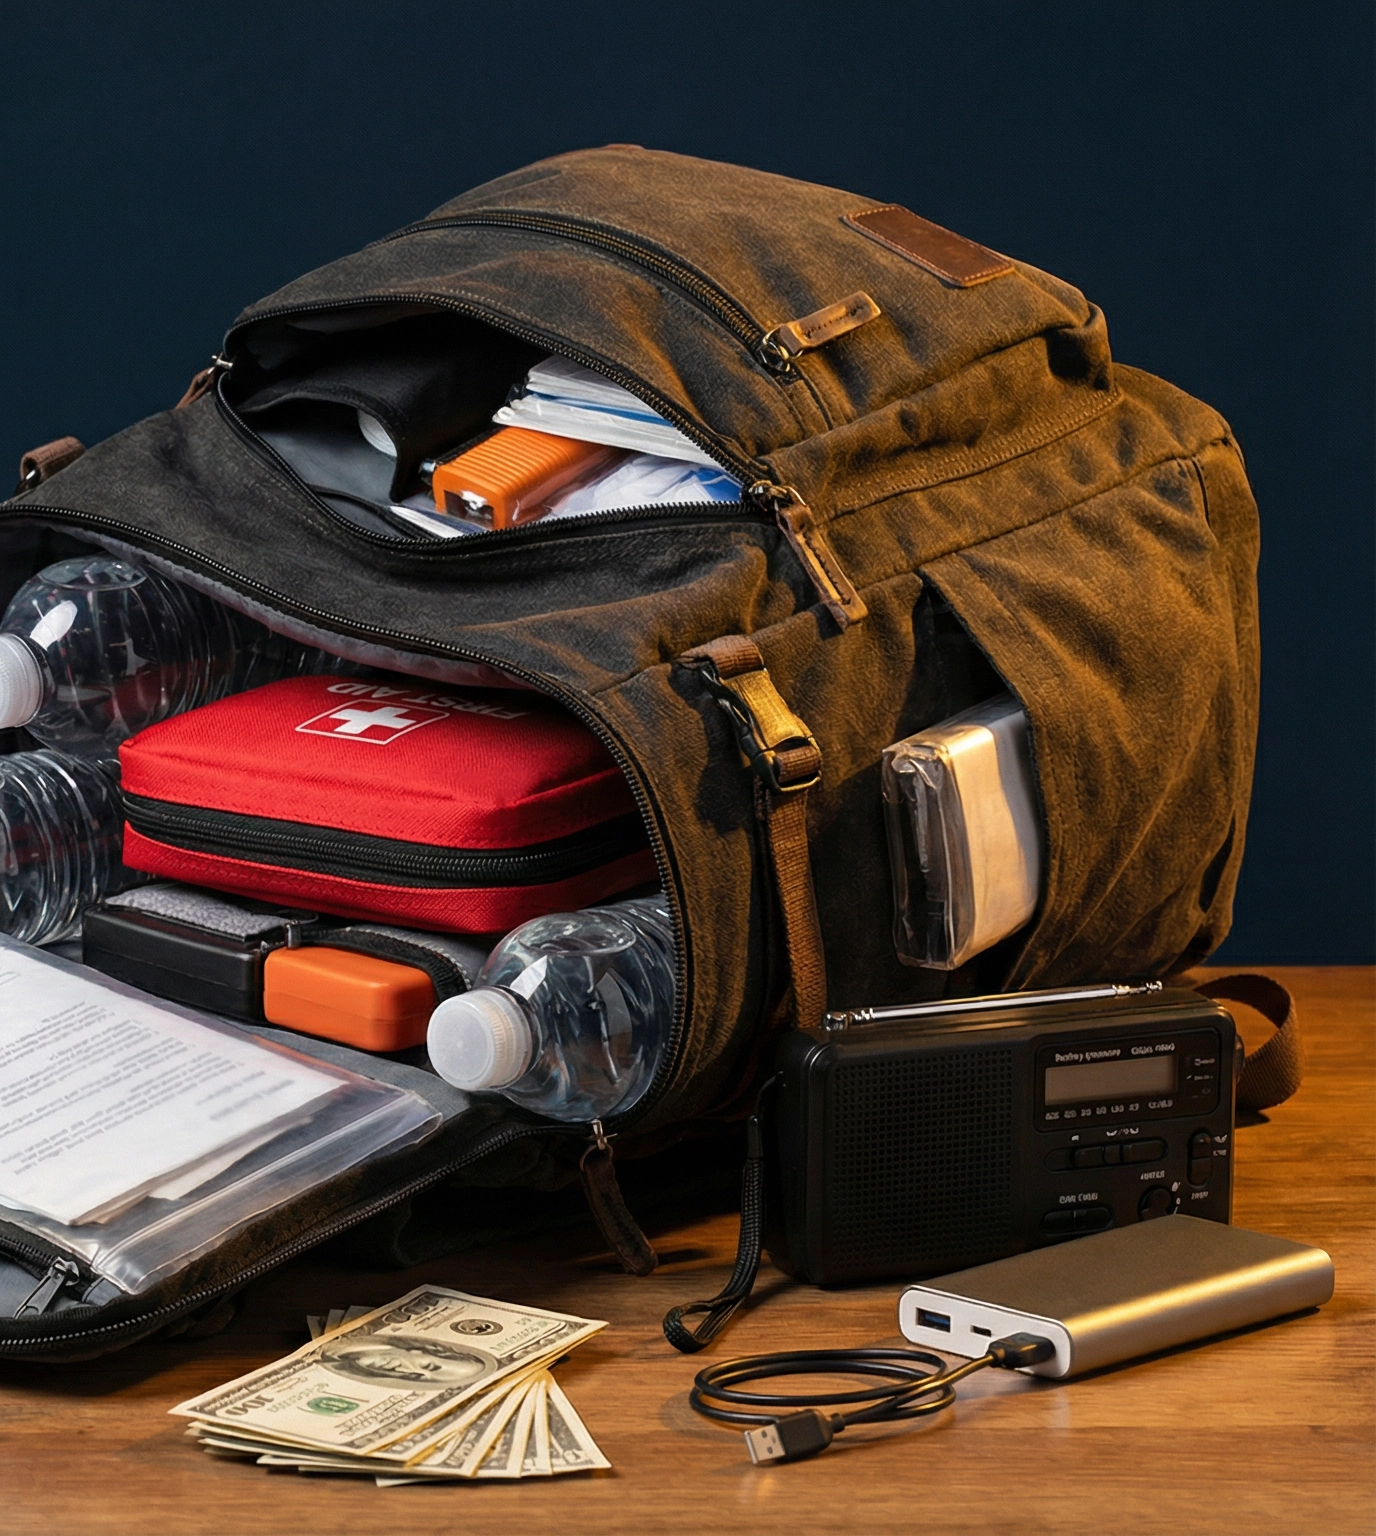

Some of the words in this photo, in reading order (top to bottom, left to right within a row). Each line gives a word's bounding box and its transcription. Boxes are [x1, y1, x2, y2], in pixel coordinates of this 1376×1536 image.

[327, 682, 410, 698] AID
[402, 694, 529, 719] FIRST
[224, 1395, 275, 1416] 100
